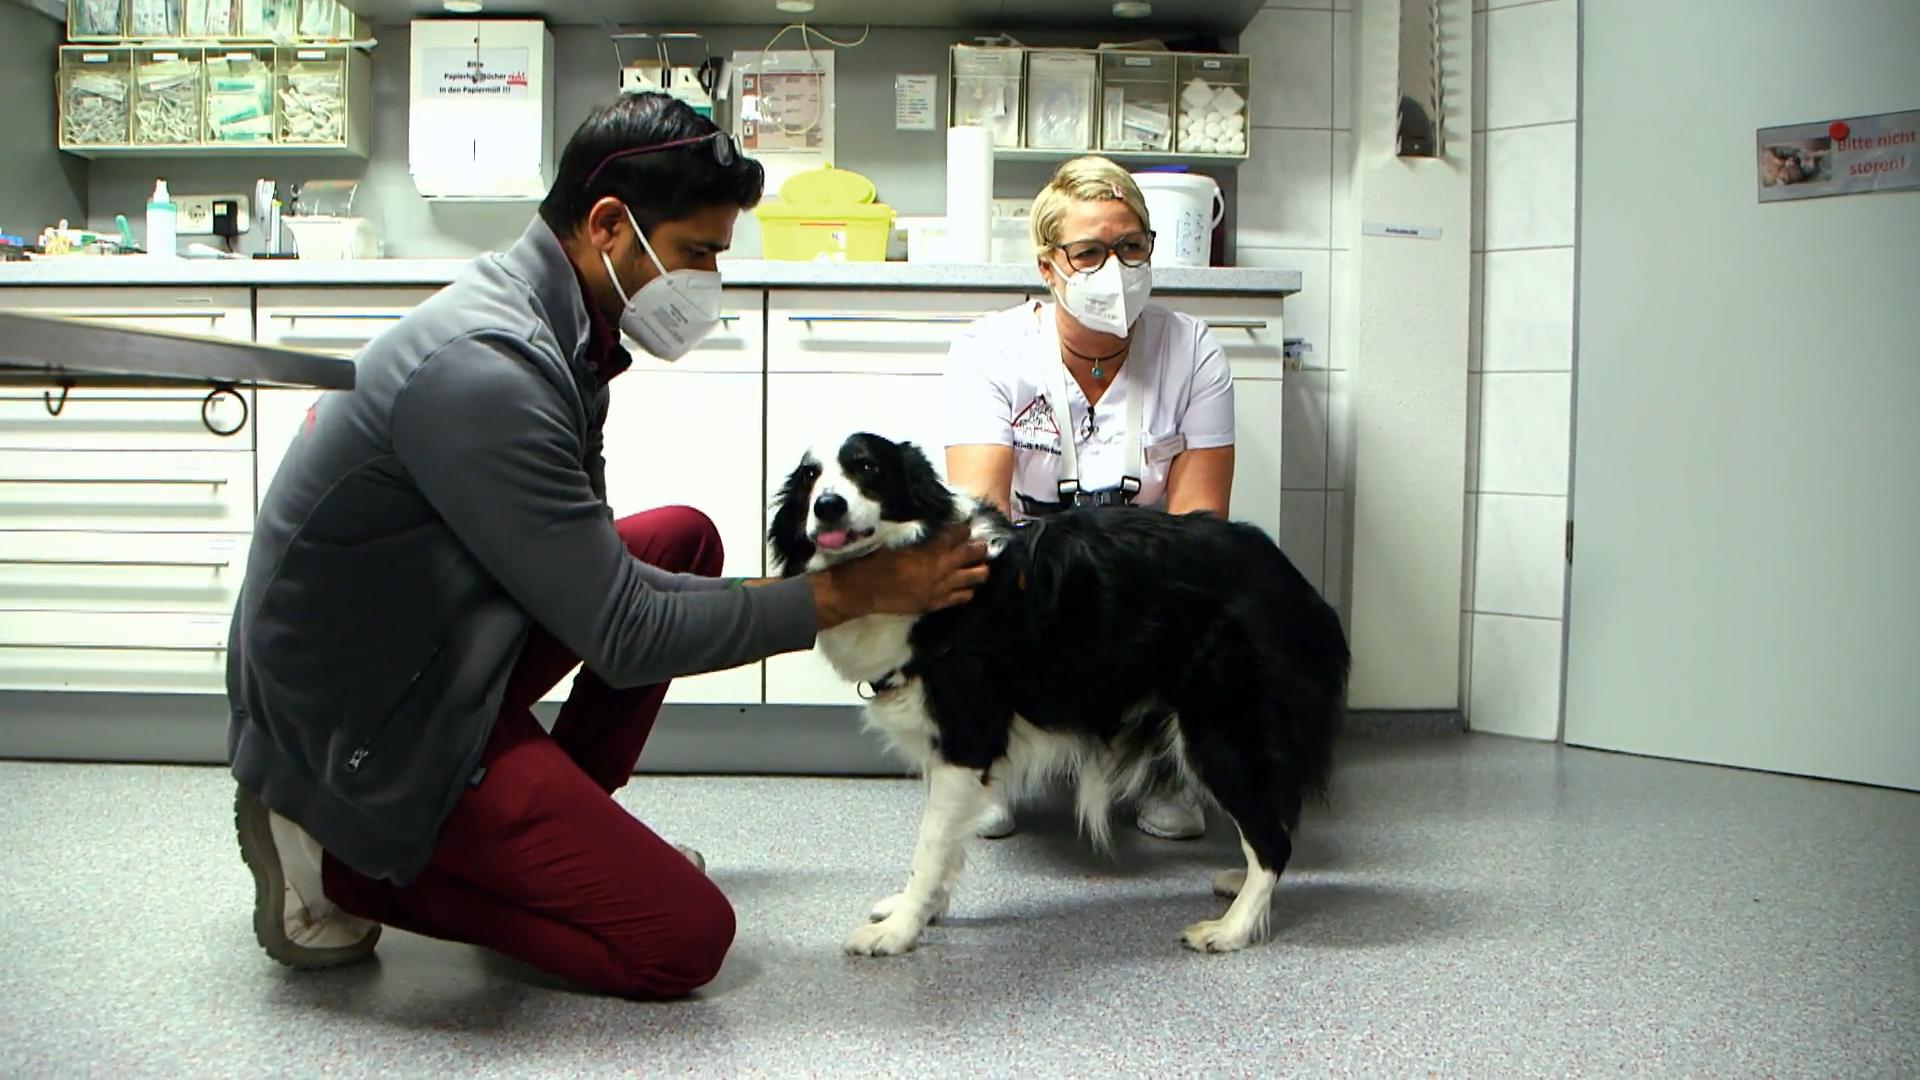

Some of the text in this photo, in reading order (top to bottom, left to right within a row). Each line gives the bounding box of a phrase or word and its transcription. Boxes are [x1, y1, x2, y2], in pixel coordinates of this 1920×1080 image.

[448, 86, 461, 94] den
[463, 86, 500, 95] Papiermüll
[1838, 130, 1916, 152] Bitte nicht
